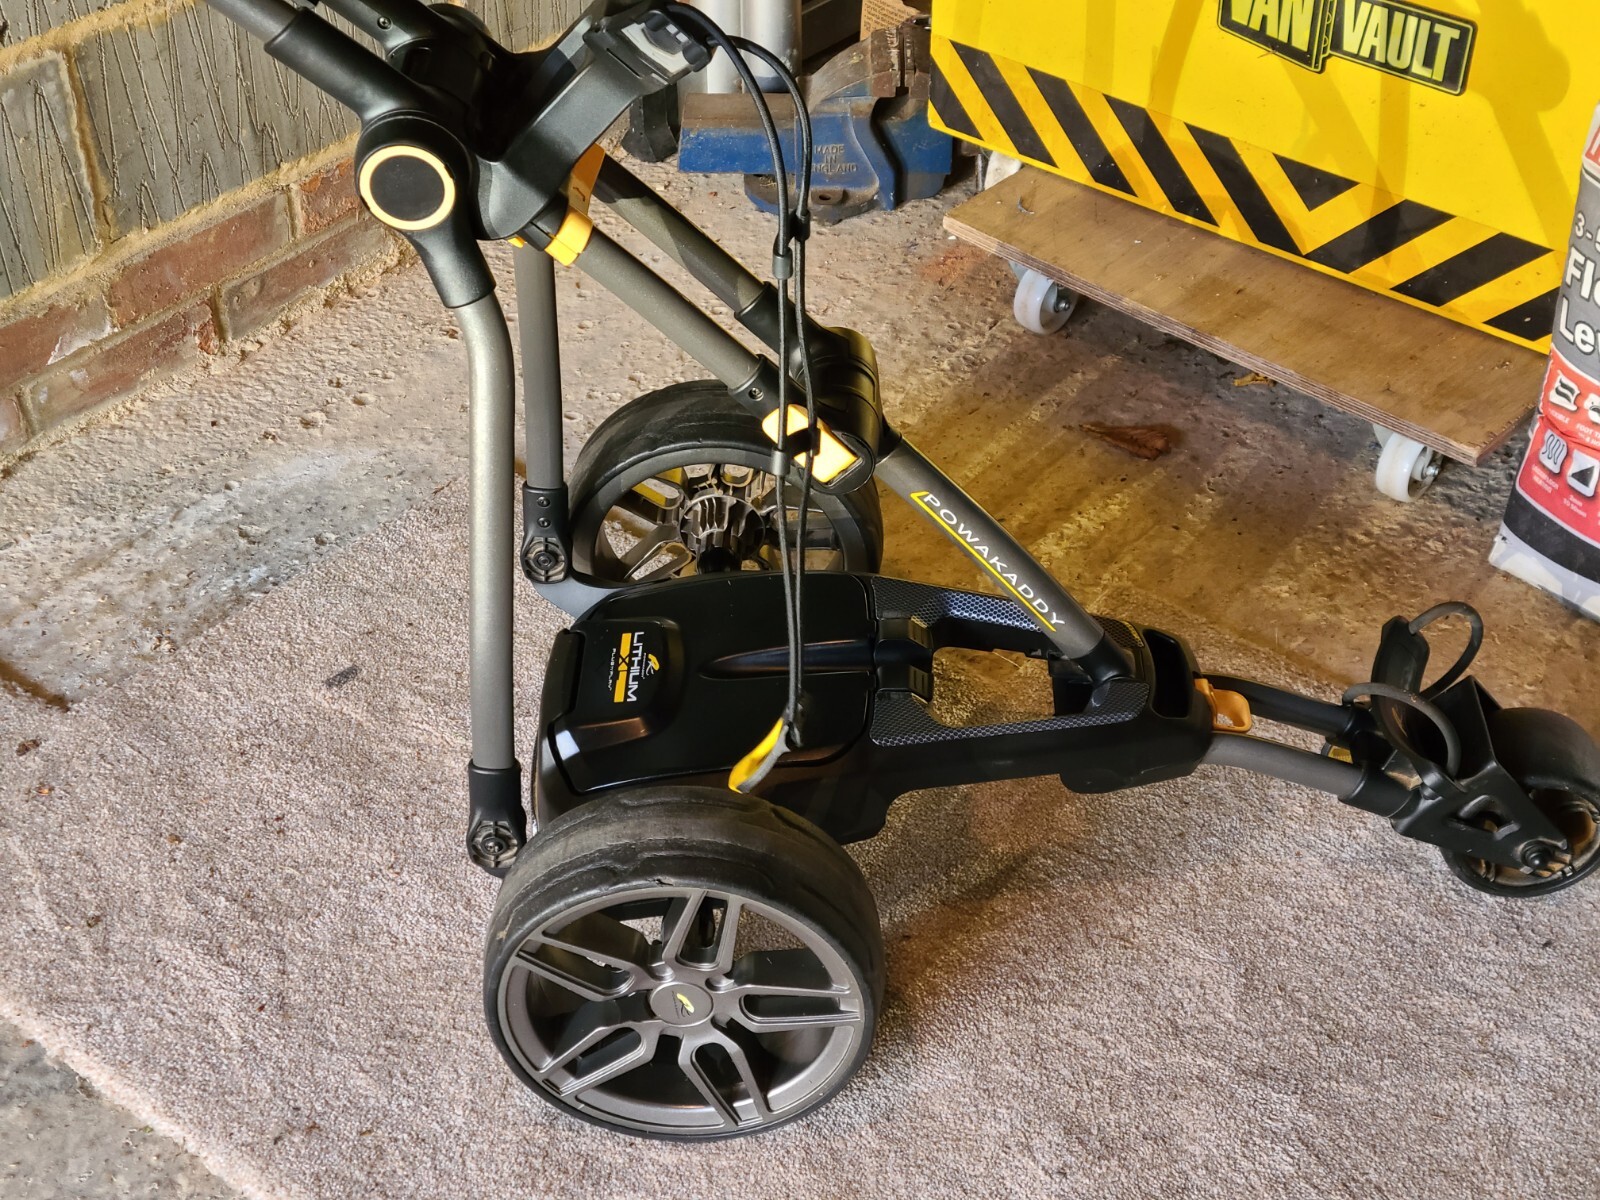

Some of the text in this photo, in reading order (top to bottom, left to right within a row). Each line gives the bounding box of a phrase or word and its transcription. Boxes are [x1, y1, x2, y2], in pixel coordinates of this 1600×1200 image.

[1342, 0, 1460, 82] VAULT
[814, 144, 845, 155] MADE
[825, 155, 837, 164] IN
[1559, 296, 1600, 354] Le
[923, 493, 1065, 625] POWAKADDY
[627, 631, 645, 702] LITHIUM
